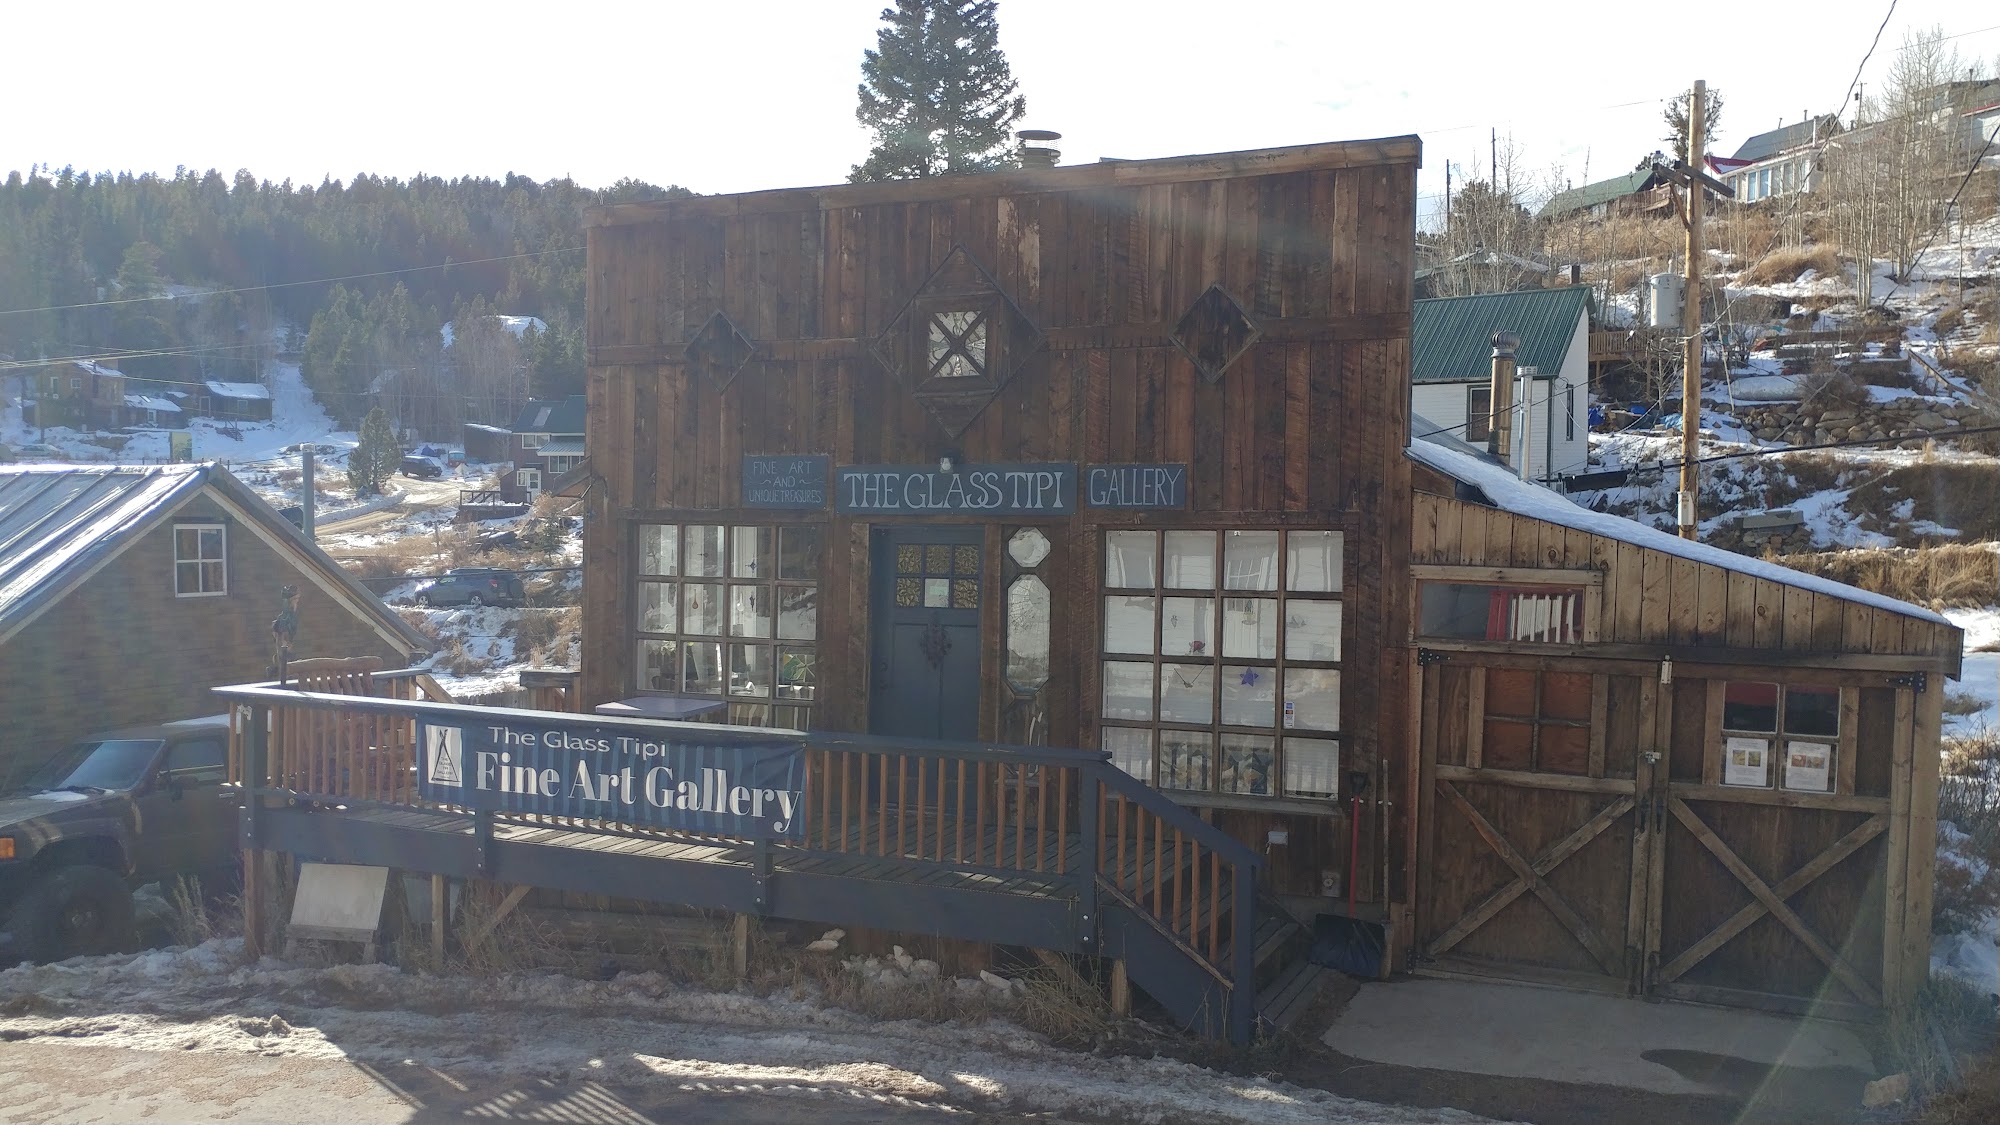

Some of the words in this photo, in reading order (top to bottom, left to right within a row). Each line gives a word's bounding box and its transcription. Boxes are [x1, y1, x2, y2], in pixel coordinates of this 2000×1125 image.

[753, 461, 777, 474] FINE
[788, 460, 812, 474] ART
[772, 475, 796, 488] AND
[748, 489, 779, 503] UNIQUE
[843, 473, 900, 508] THE
[903, 471, 1003, 509] GLASS
[1005, 471, 1063, 509] TIPI
[1090, 467, 1182, 507] GALLERY
[487, 726, 536, 747] The
[543, 730, 611, 752] Glass
[616, 736, 666, 761] Tipi
[475, 750, 561, 798] Fine
[567, 759, 637, 805] Art
[645, 766, 803, 833] Gallery
